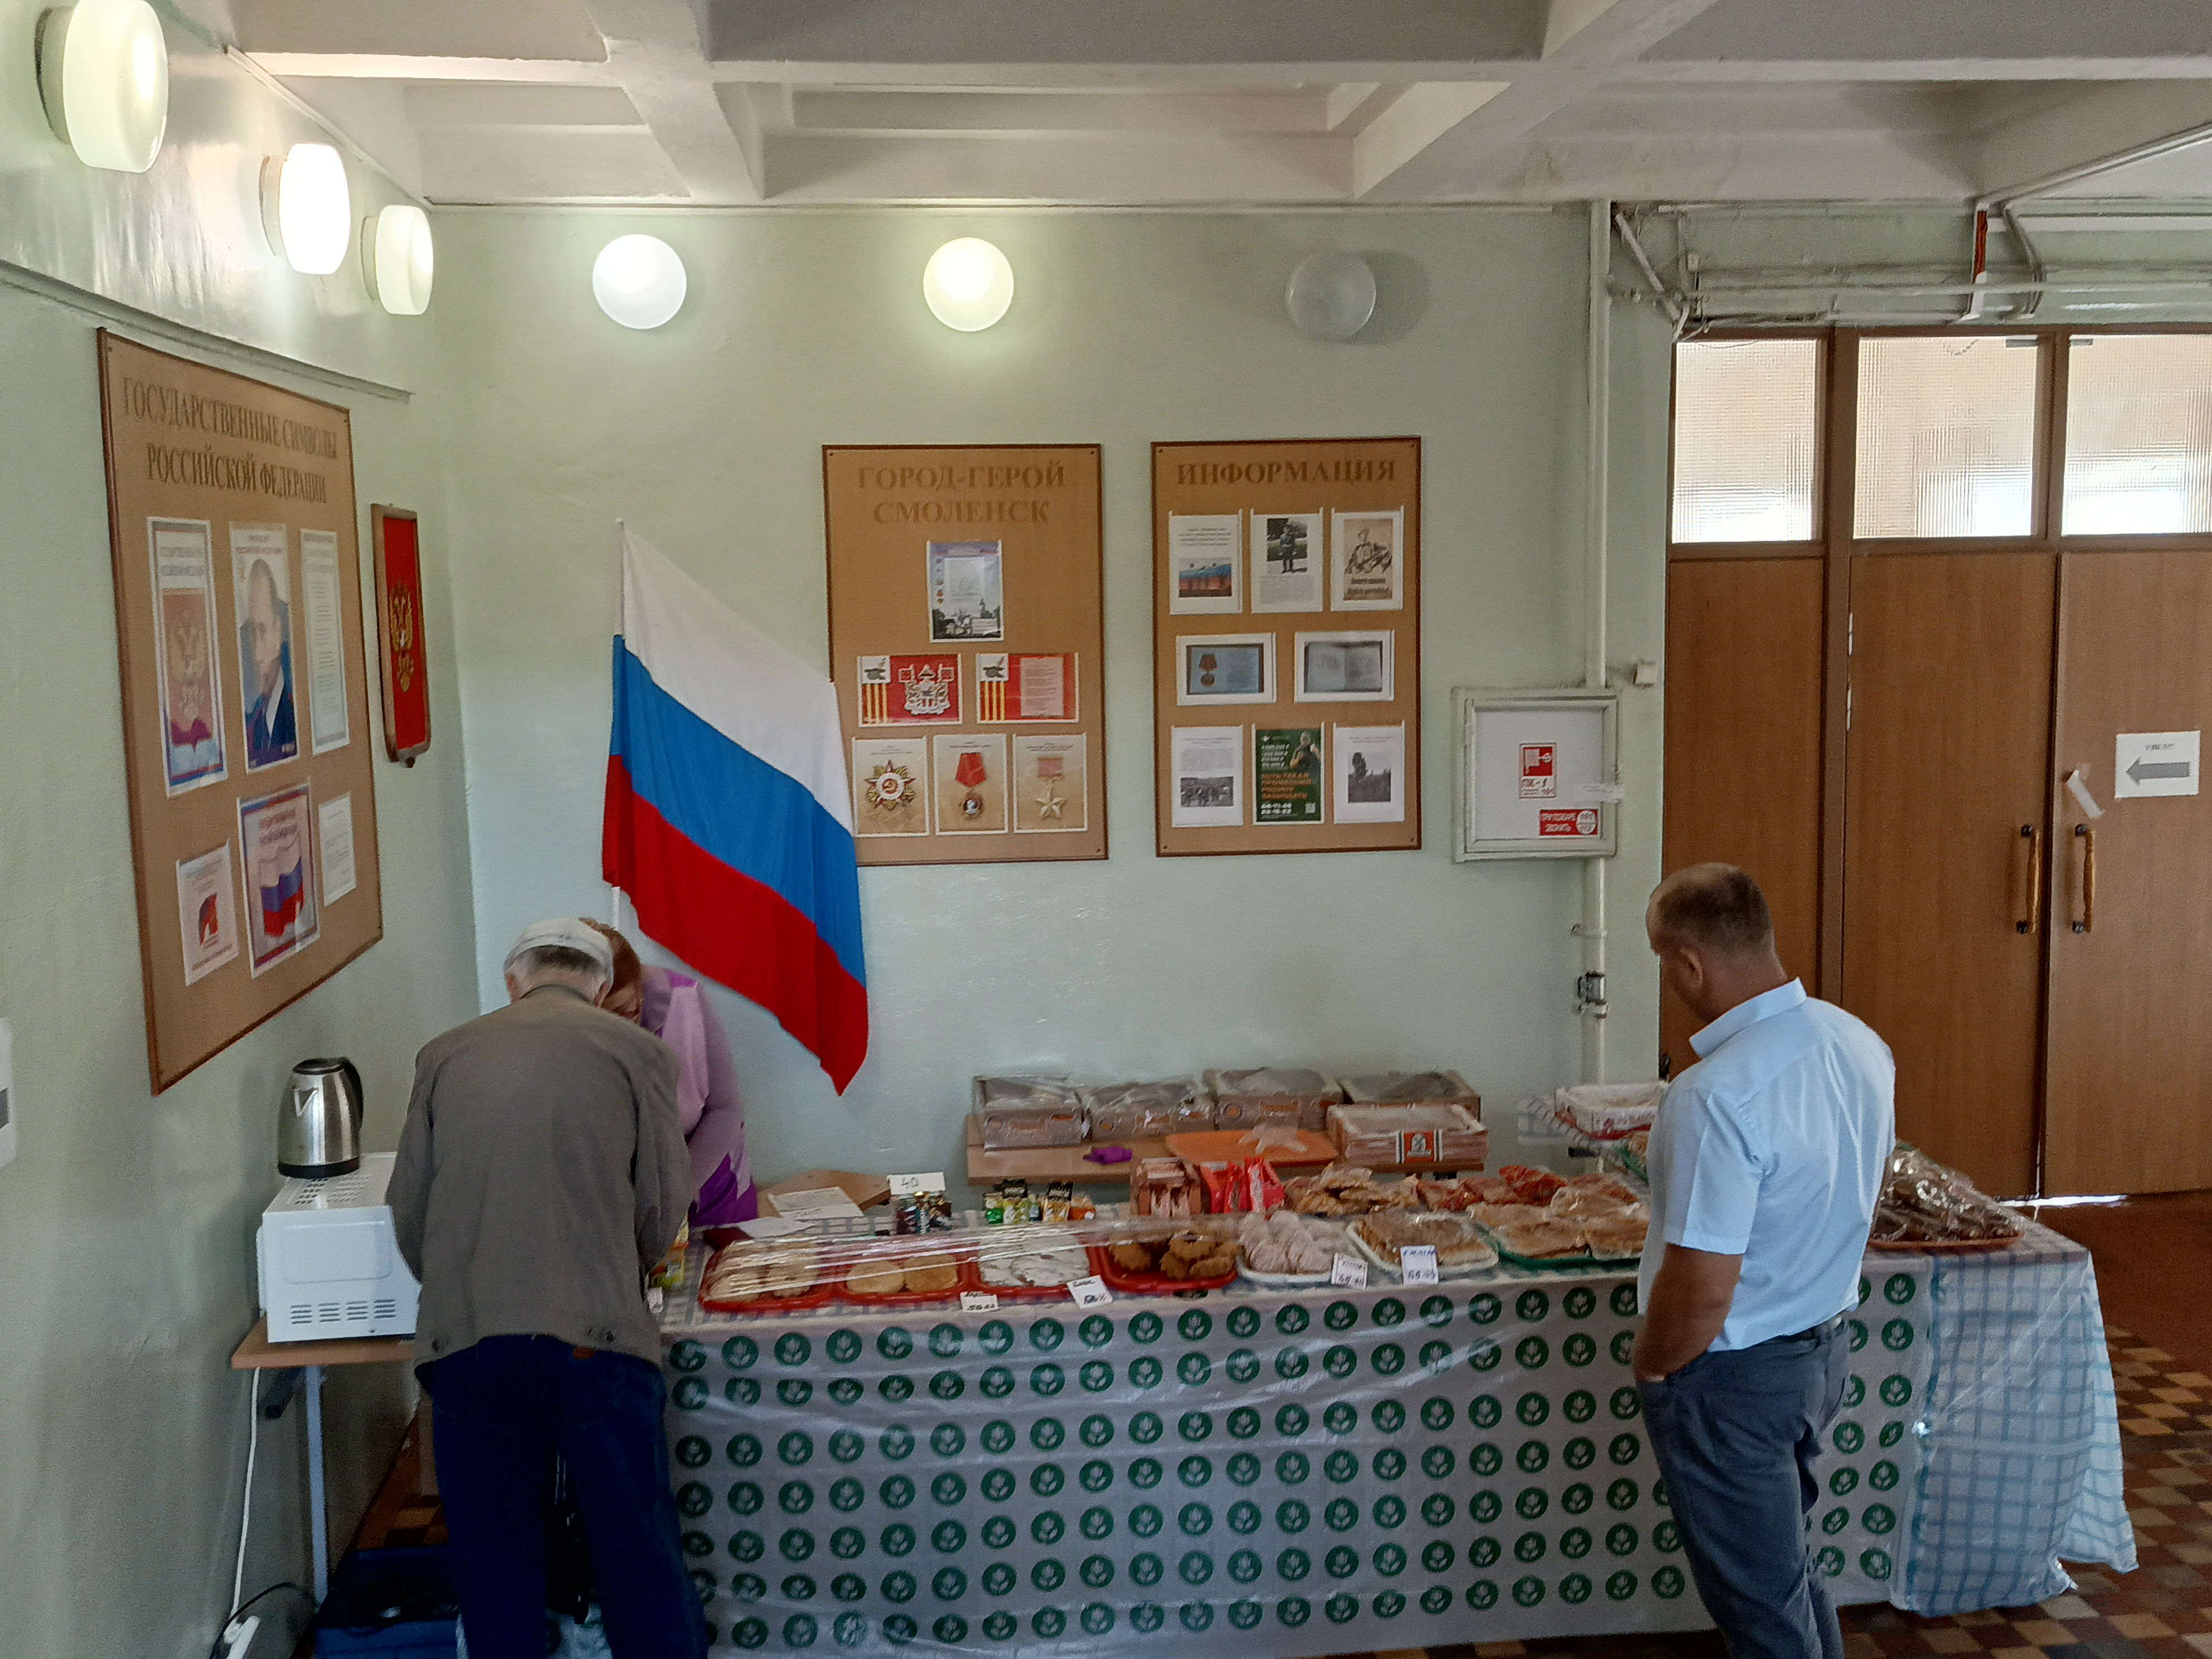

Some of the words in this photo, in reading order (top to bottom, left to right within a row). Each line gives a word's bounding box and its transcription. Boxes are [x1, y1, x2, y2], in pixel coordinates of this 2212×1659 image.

[122, 376, 281, 447] ГОСУДАРСТВЕННЫЕ
[147, 442, 258, 492] РОССИЙСКОЙ
[260, 462, 327, 503] ФЕДЕРАЦИИ
[858, 459, 1065, 491] ГОРОД-ГЕРОЙ
[1175, 459, 1396, 486] ИНФОРМАЦИЯ
[872, 499, 1051, 525] СМОЛЕНСК
